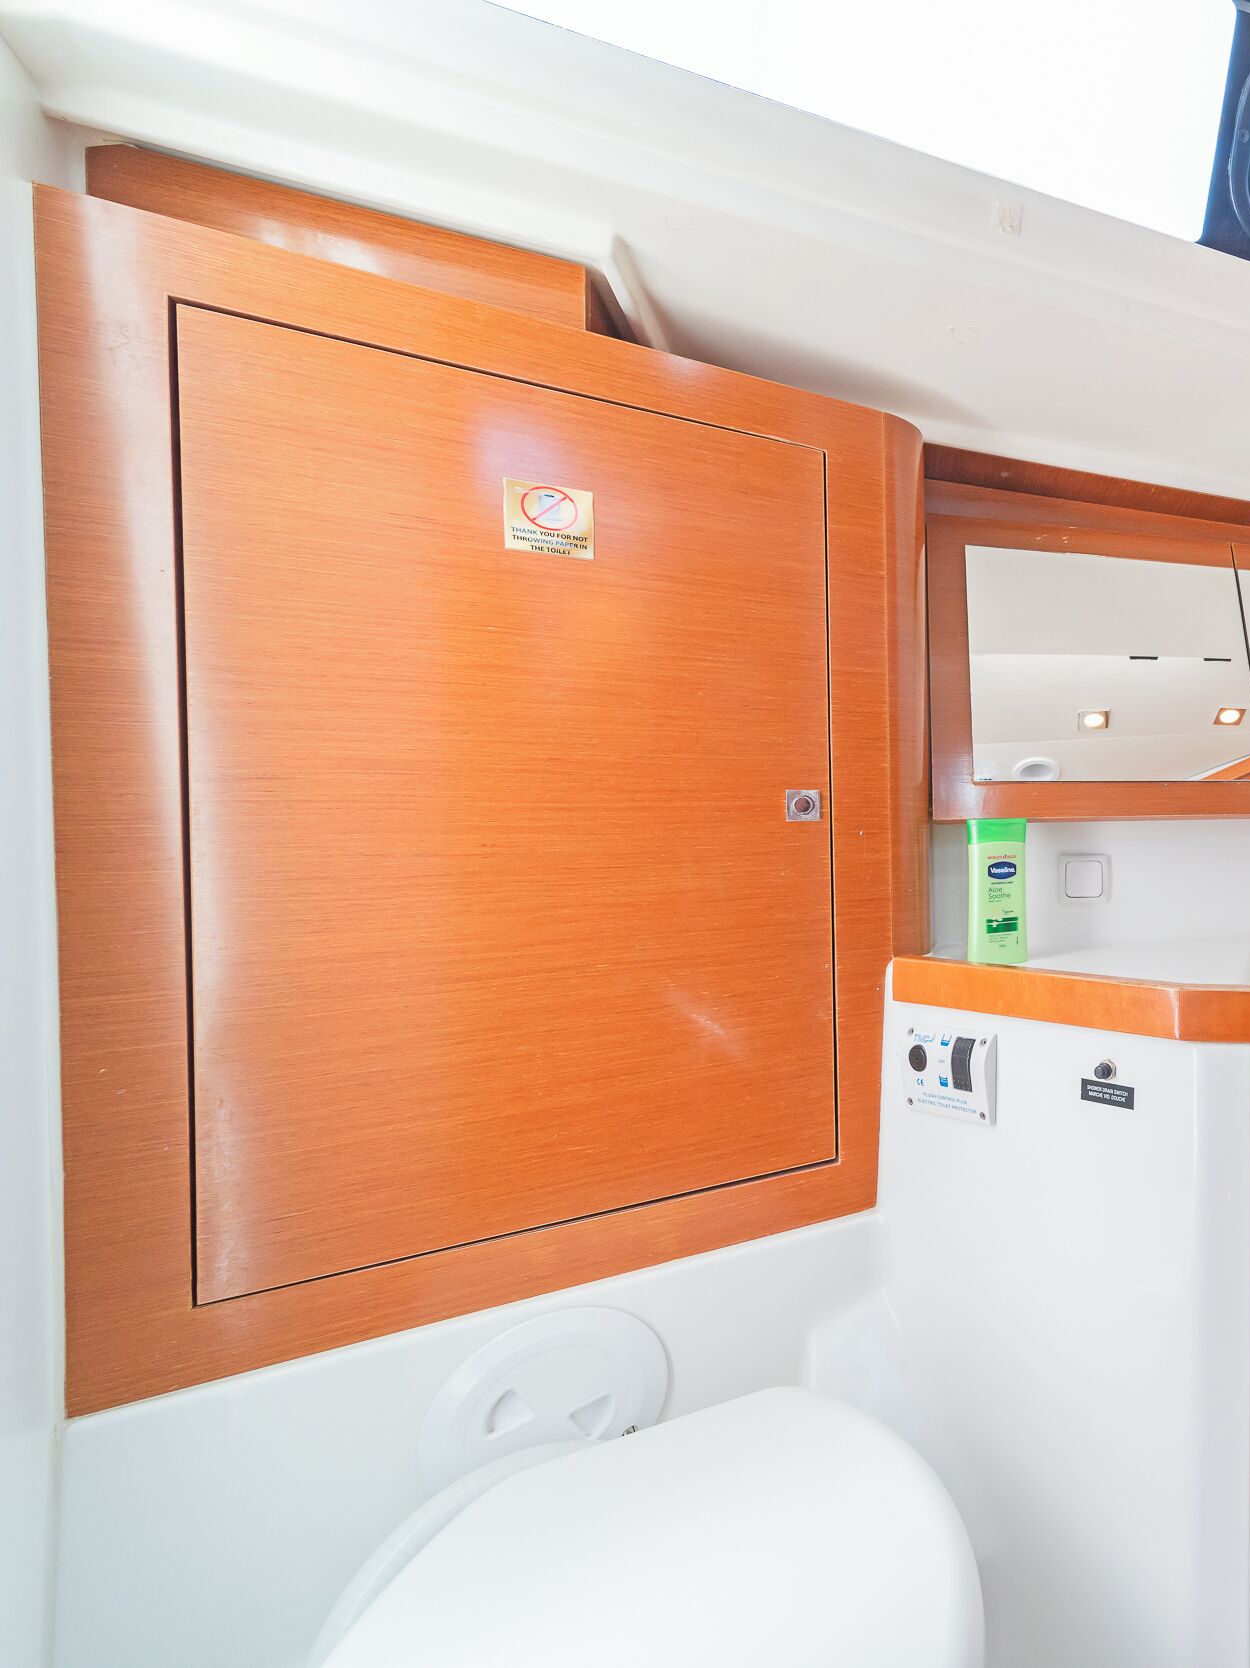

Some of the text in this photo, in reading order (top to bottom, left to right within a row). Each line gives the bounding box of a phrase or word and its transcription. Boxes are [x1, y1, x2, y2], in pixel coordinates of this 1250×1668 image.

[511, 526, 538, 535] THANK
[512, 535, 555, 545] THROWING
[555, 540, 579, 549] PAPER
[546, 547, 571, 555] TOILET
[937, 1095, 956, 1103] CONTROL
[917, 1098, 936, 1106] ELECTRIC
[951, 1105, 976, 1113] PROTECTOR
